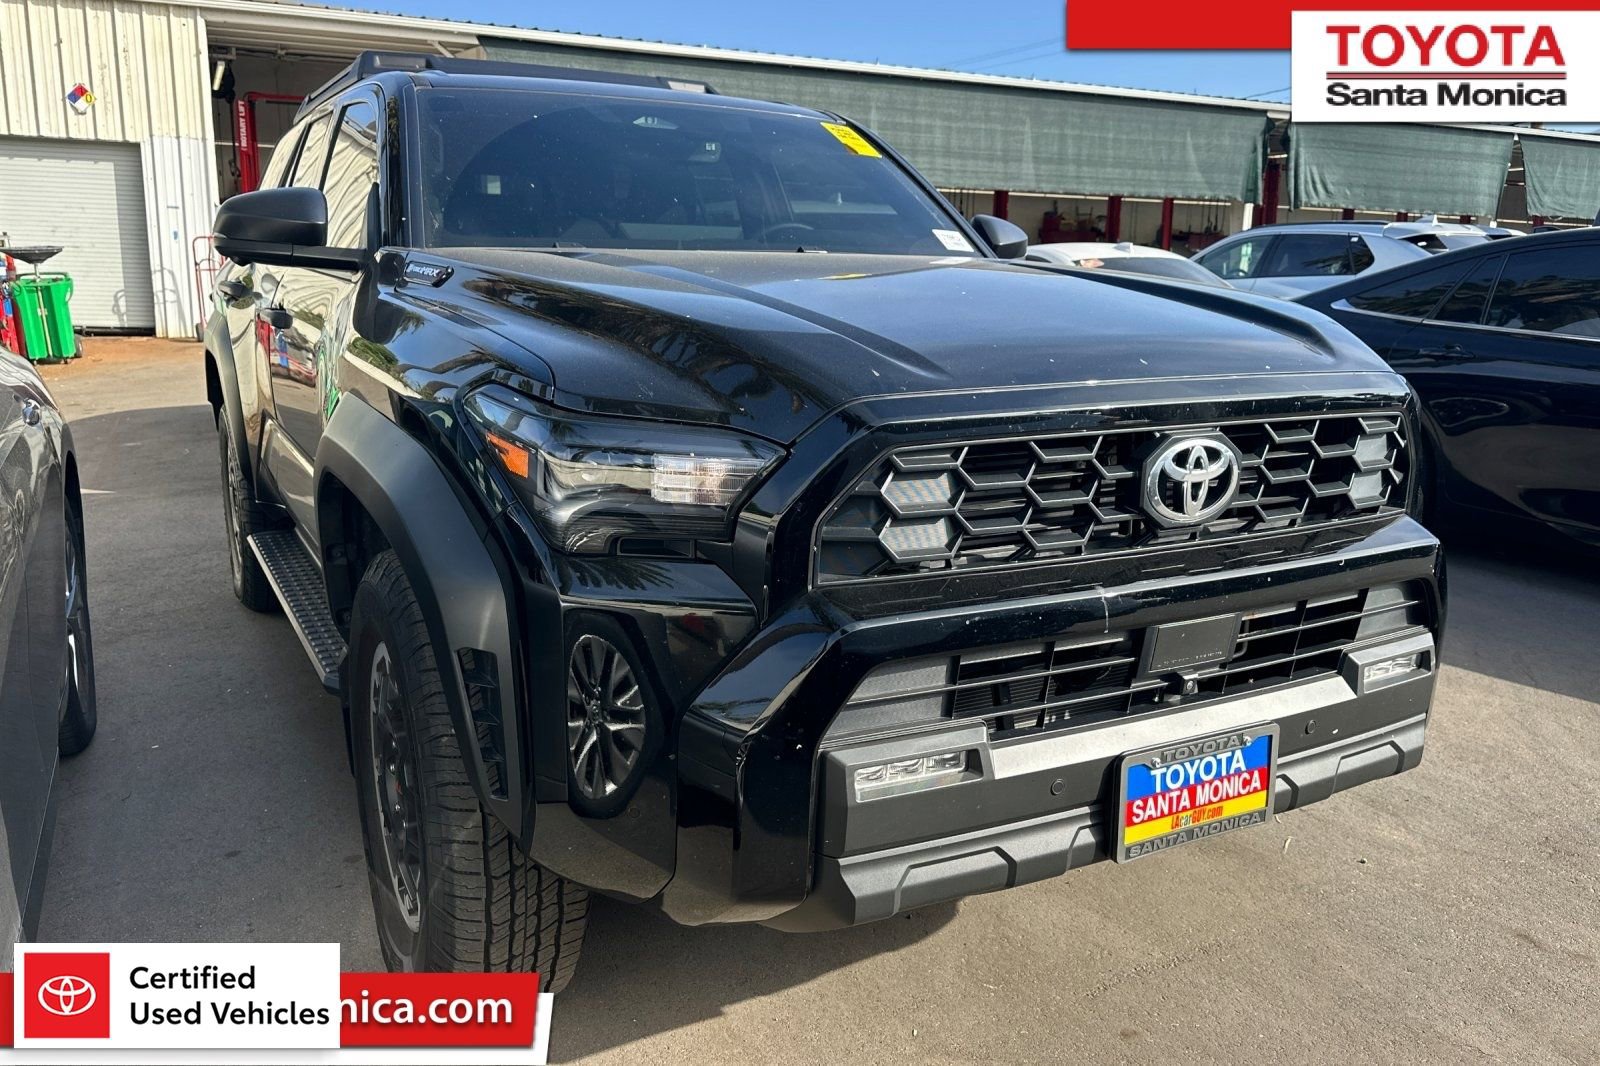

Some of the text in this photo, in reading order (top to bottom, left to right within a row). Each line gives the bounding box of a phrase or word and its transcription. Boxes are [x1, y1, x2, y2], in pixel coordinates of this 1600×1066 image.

[85, 94, 92, 103] 0
[238, 100, 247, 147] ROTARY LIFT
[1163, 735, 1240, 762] TOYOTA
[1151, 749, 1247, 793] TOYOTA
[1132, 770, 1262, 824] SANTA MONICA
[1171, 806, 1224, 830] LAcarGUY.com
[1129, 812, 1261, 858] SANTA MONICA
